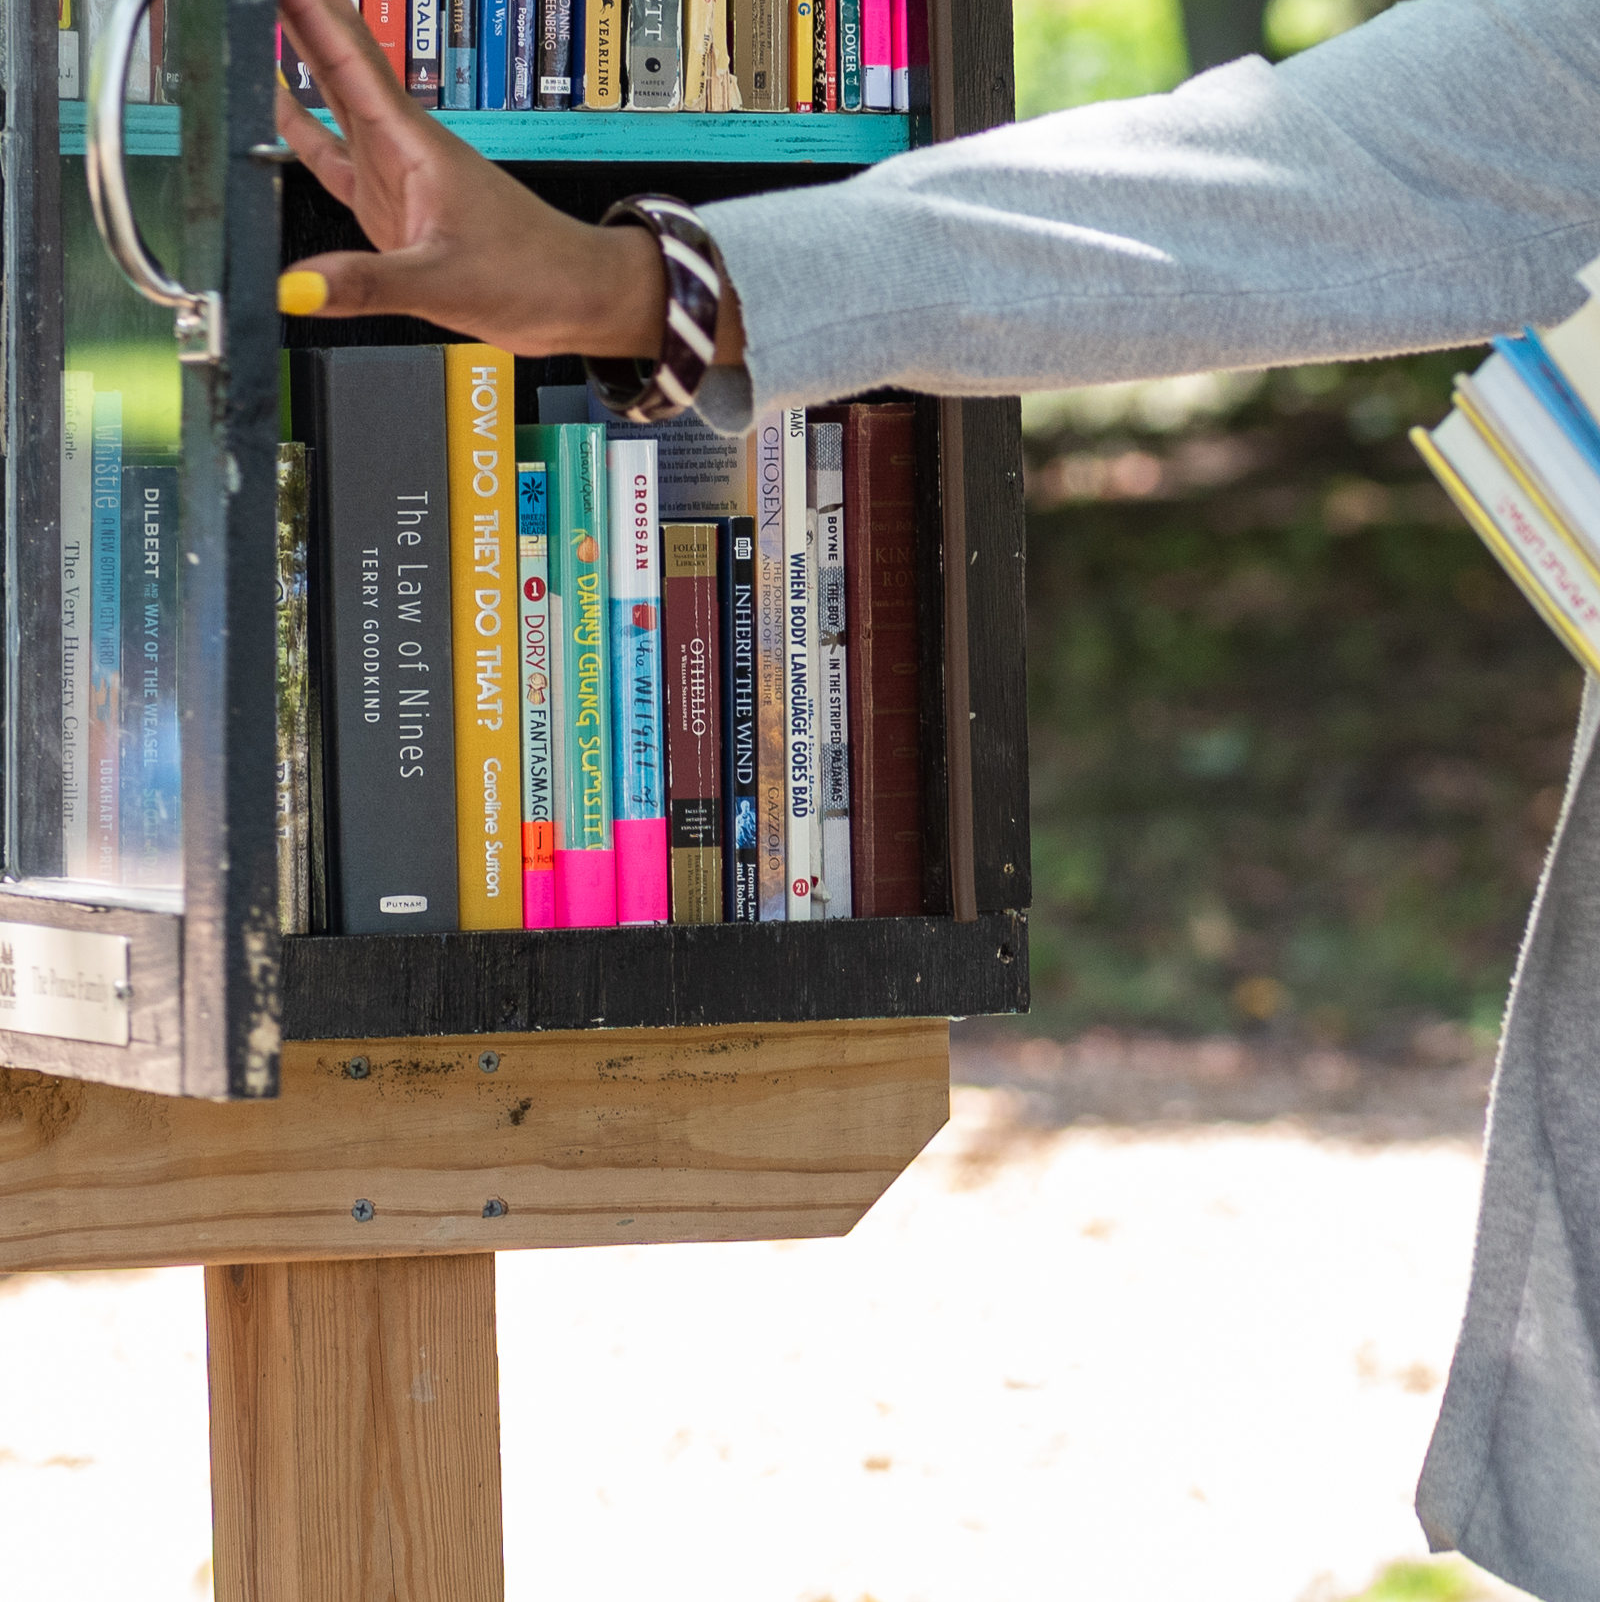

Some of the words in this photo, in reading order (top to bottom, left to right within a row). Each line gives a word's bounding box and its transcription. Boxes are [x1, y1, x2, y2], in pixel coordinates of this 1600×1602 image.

[494, 8, 505, 36] Wyss
[598, 18, 610, 97] YEARLING
[845, 23, 856, 73] DOVER
[635, 90, 671, 98] PERENNIAL
[470, 364, 500, 441] HOW
[472, 449, 499, 498] DO
[762, 426, 782, 531] CHOSEN
[144, 489, 160, 579] DILBERT
[397, 490, 429, 546] The
[521, 527, 546, 535] READS
[634, 474, 649, 570] CROSSAN
[827, 516, 838, 561] BOYNE
[64, 541, 80, 580] The
[473, 509, 500, 580] THEY
[673, 544, 708, 552] FOLGER
[762, 553, 771, 581] AND
[143, 582, 151, 598] THE
[151, 582, 159, 598] AND
[362, 547, 379, 608] TERRY
[397, 564, 429, 623] Law
[773, 560, 782, 582] THE
[790, 552, 806, 600] WHEN
[828, 582, 838, 605] THE
[62, 586, 80, 630] Very
[144, 603, 159, 638] WAY
[474, 589, 501, 637] DO
[735, 584, 751, 668] INHERIT
[762, 583, 772, 628] FRODO
[774, 585, 782, 644] JOURNEYS
[791, 606, 807, 647] BODY
[828, 607, 839, 627] BOY
[144, 642, 159, 663] OF
[398, 641, 430, 672] of
[763, 630, 772, 646] OF
[763, 647, 772, 672] THE
[774, 646, 783, 664] OF
[62, 636, 79, 709] Hungry
[143, 669, 158, 698] THE
[363, 619, 380, 723] GOODKIND
[775, 666, 783, 701] BILBO
[830, 658, 840, 670] IN
[830, 672, 840, 697] THE
[476, 644, 503, 731] THAT?
[690, 638, 706, 736] OTHELLO
[736, 678, 752, 718] THE
[763, 673, 772, 707] SHIRE
[791, 653, 807, 735] LANGUAGE
[143, 703, 158, 768] WEASEL
[399, 689, 430, 778] Nines
[830, 701, 841, 744] STRIPED
[63, 716, 79, 822] Caterpillar
[736, 722, 753, 785] WIND
[791, 742, 808, 784] GOES
[831, 748, 843, 802] PAJAMAS
[483, 757, 502, 835] Caroline
[792, 786, 808, 818] BAD
[767, 786, 780, 871] GAZZOLO
[485, 840, 503, 898] Sutton
[386, 900, 422, 909] PUTNAM
